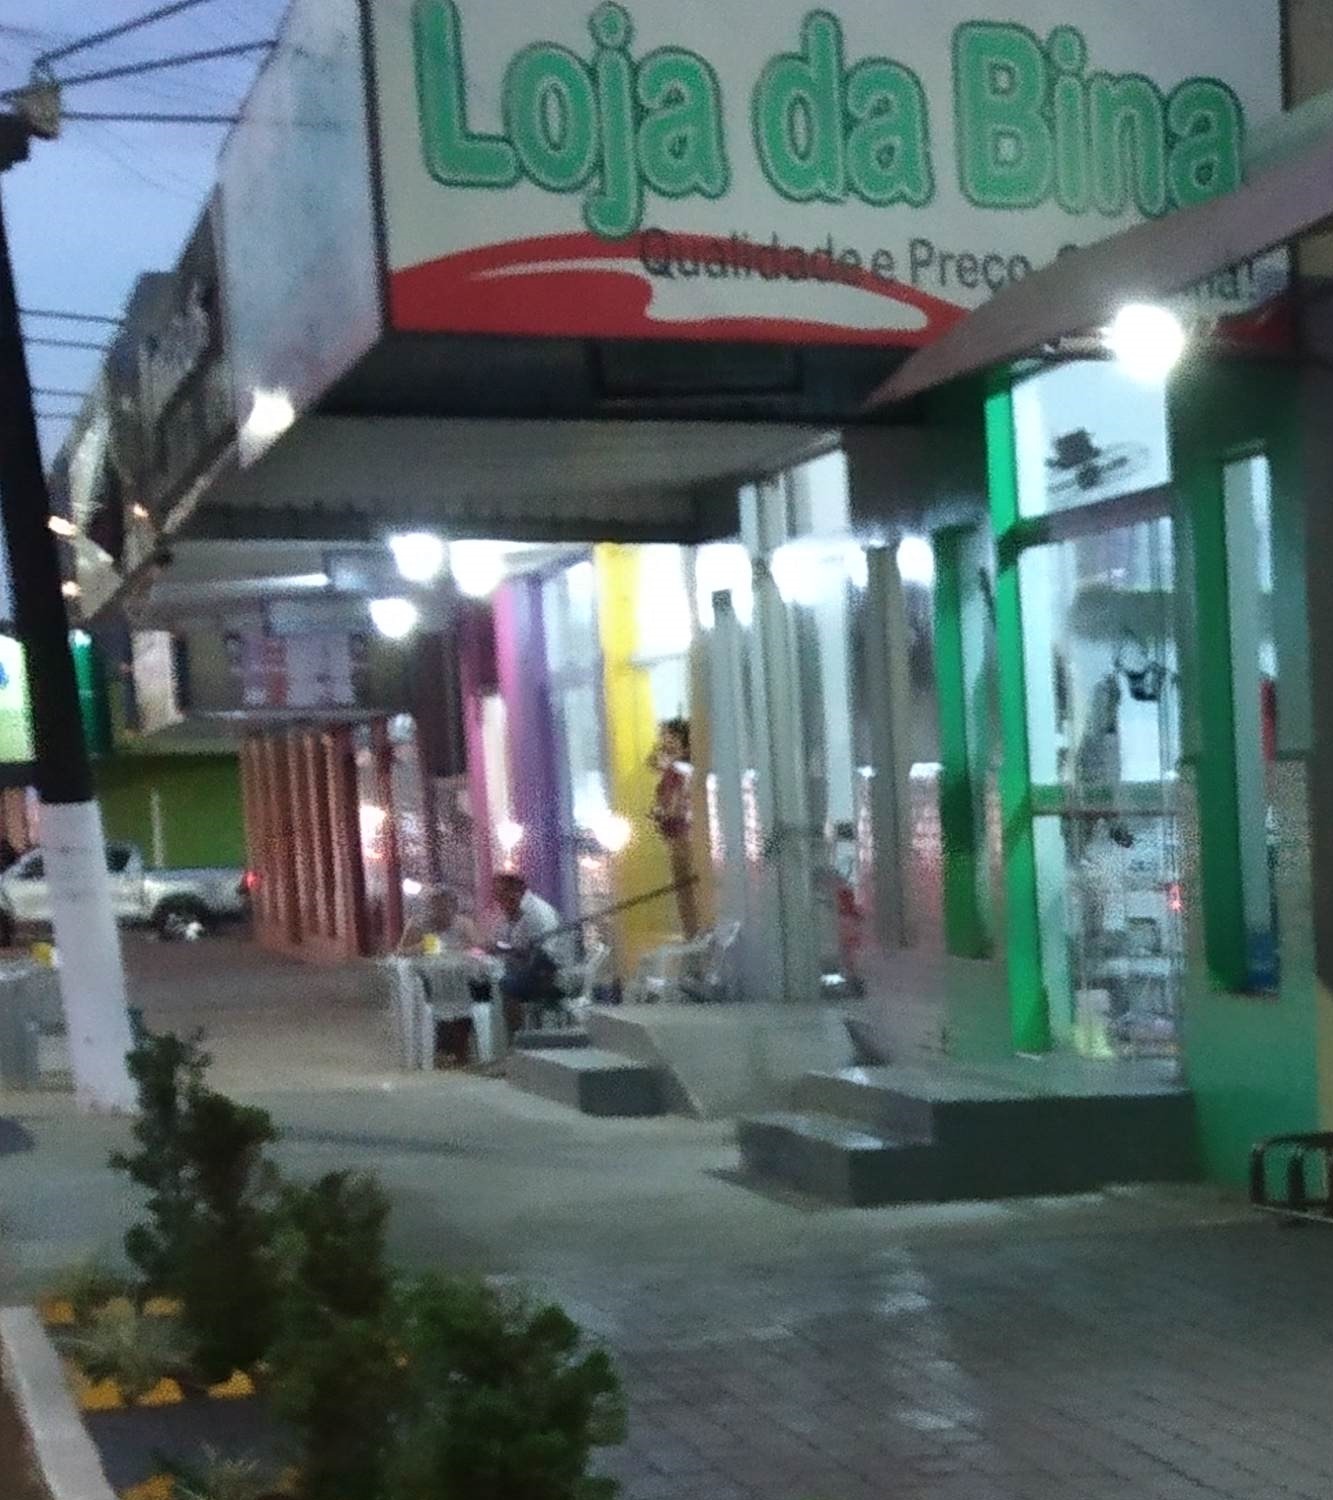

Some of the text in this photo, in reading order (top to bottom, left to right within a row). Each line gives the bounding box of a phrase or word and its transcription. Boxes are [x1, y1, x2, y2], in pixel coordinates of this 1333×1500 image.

[410, 0, 1246, 238] Loja da Bina
[640, 226, 1032, 290] Qualidade e Preço
